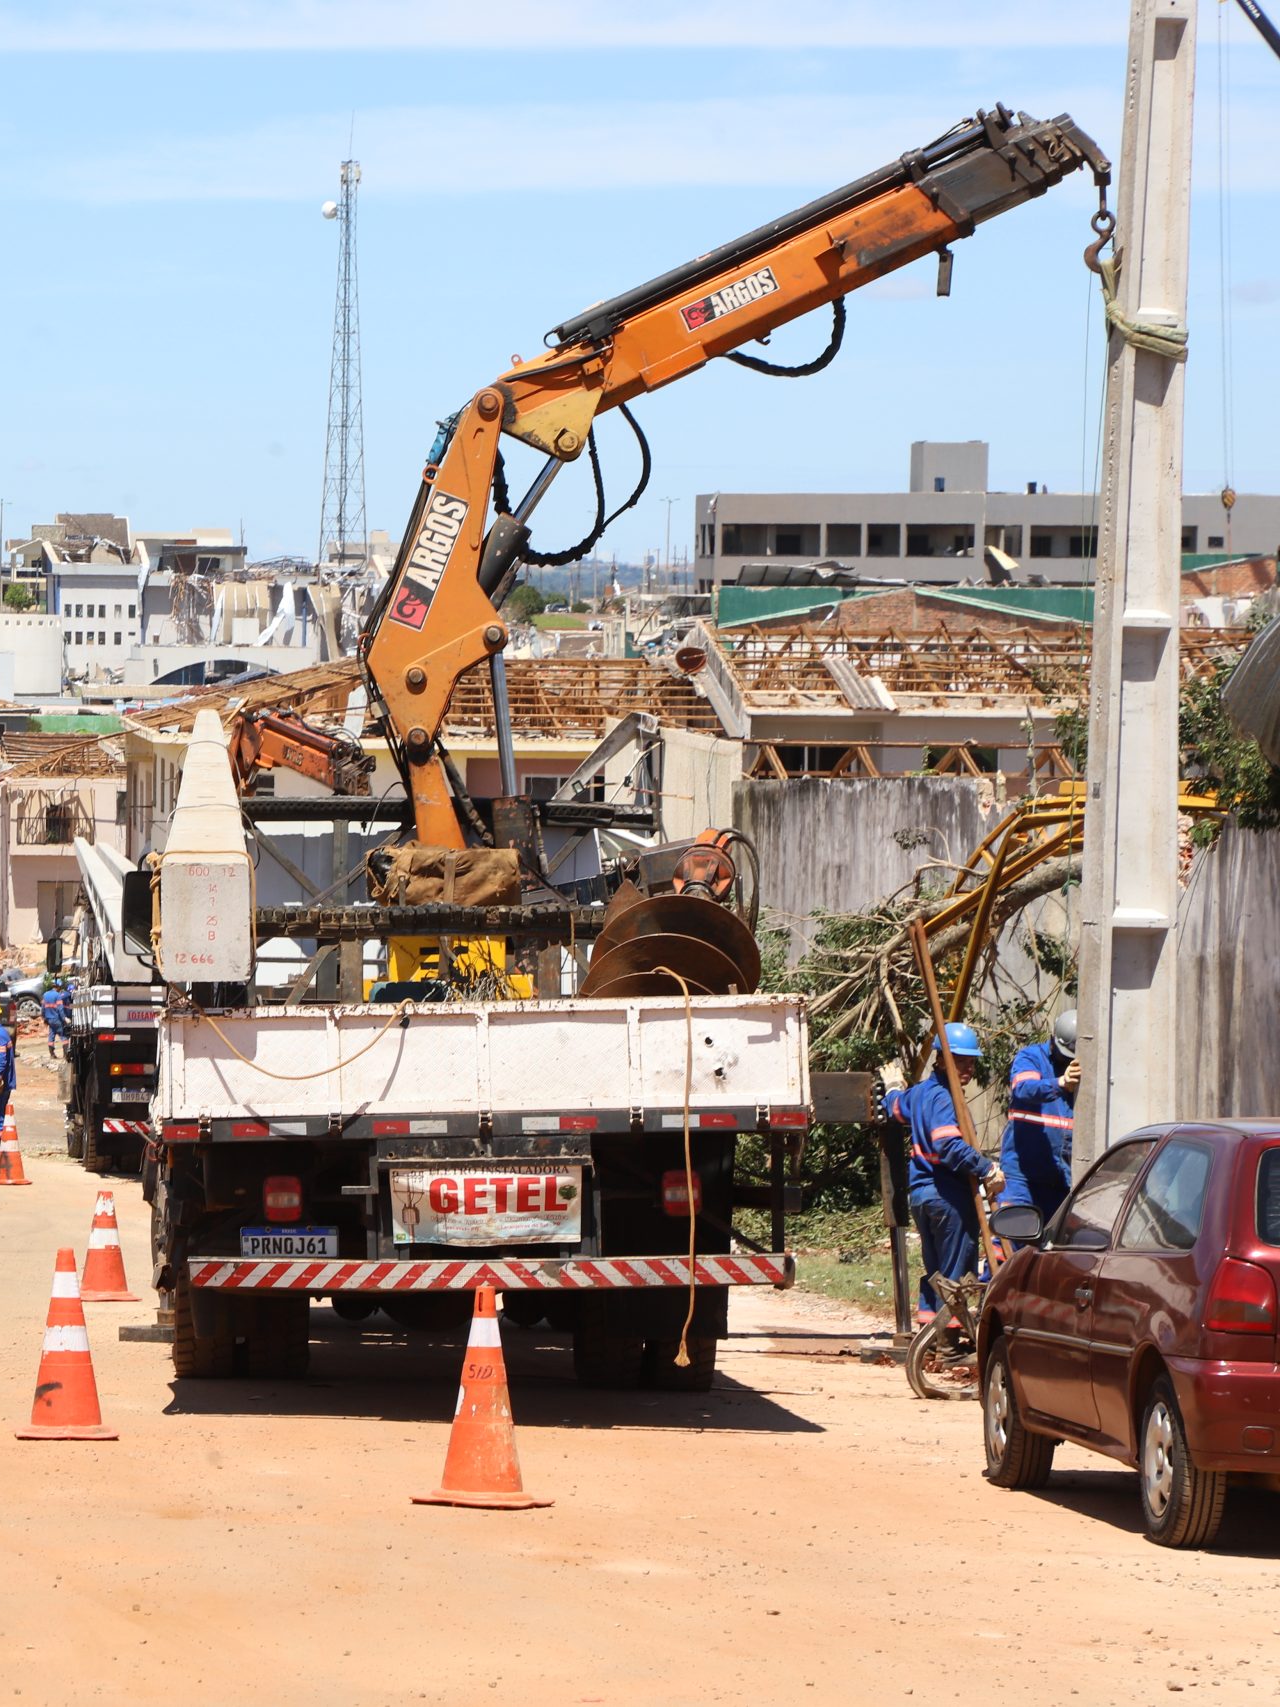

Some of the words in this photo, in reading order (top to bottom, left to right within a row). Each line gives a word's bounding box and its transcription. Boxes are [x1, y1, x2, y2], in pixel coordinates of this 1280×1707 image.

[710, 269, 775, 318] ARGOS
[405, 494, 468, 591] ARGOS
[206, 915, 218, 926] 25
[208, 931, 216, 941] B
[480, 1165, 570, 1175] INSTALADORA
[429, 1176, 568, 1215] GETEL
